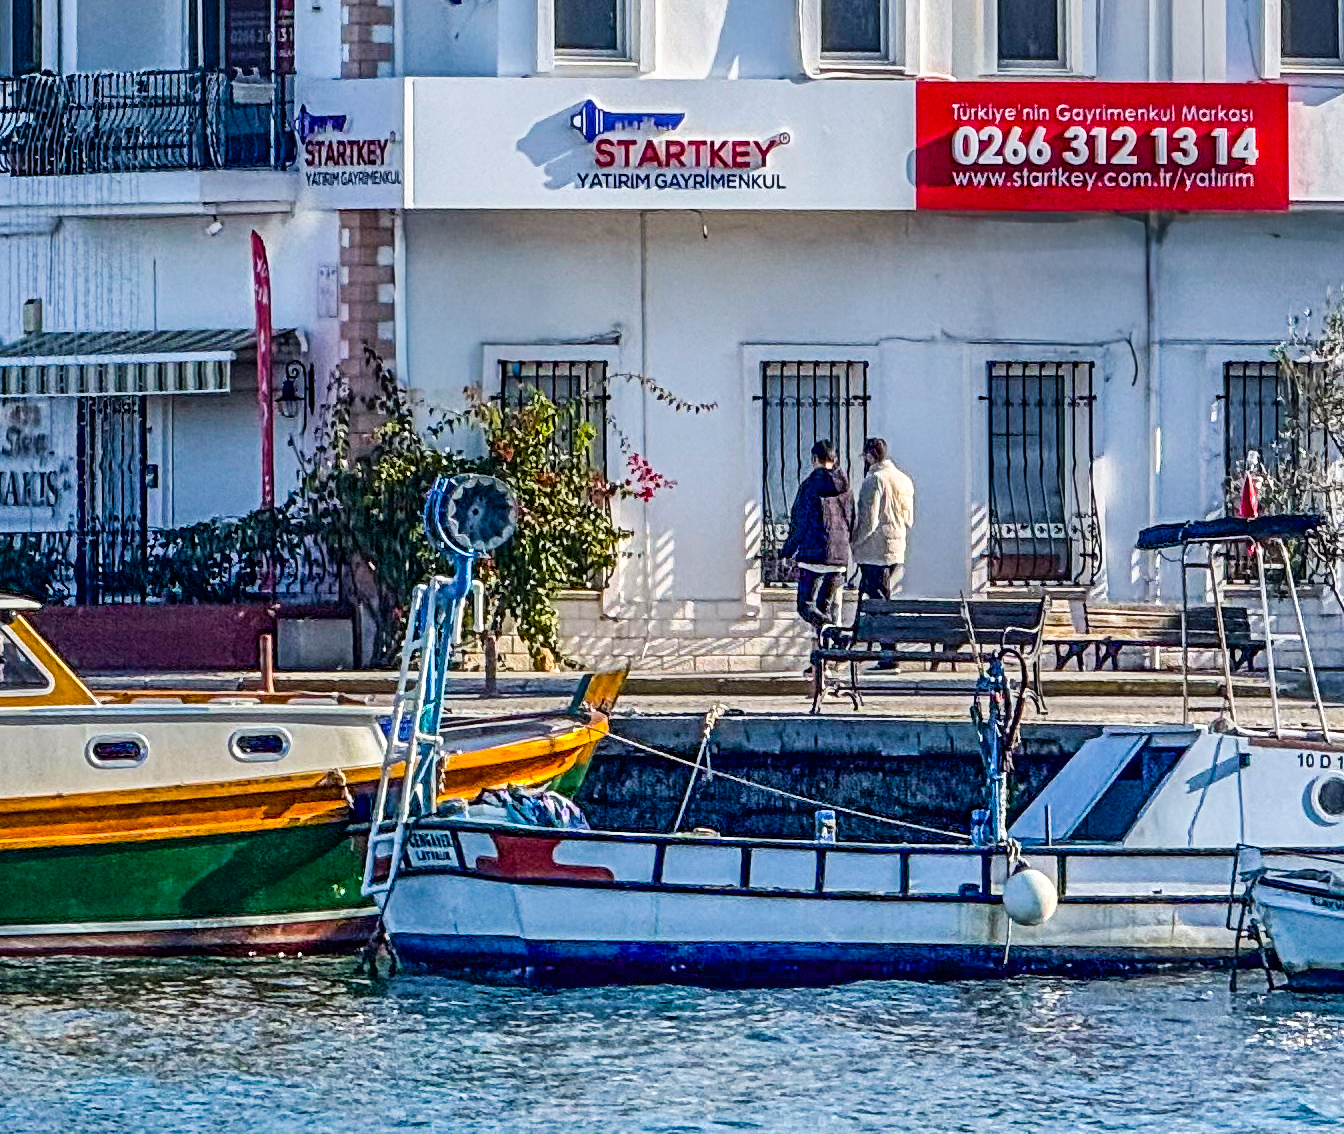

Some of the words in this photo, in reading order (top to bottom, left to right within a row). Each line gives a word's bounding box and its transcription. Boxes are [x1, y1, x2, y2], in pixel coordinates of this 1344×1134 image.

[952, 104, 1050, 123] Türkiye'nin
[1056, 104, 1175, 123] Gayrimenkul
[1182, 105, 1254, 122] Markası
[305, 139, 388, 167] STARTKEY
[595, 138, 777, 168] STARTKEY
[952, 126, 1052, 166] 0266
[1062, 126, 1138, 165] 312
[1150, 127, 1199, 165] 13
[1210, 127, 1260, 166] 14
[577, 173, 650, 189] YATIRIM
[655, 170, 787, 189] GAYRİMENKUL
[1297, 753, 1315, 768] 10
[1320, 754, 1332, 768] D
